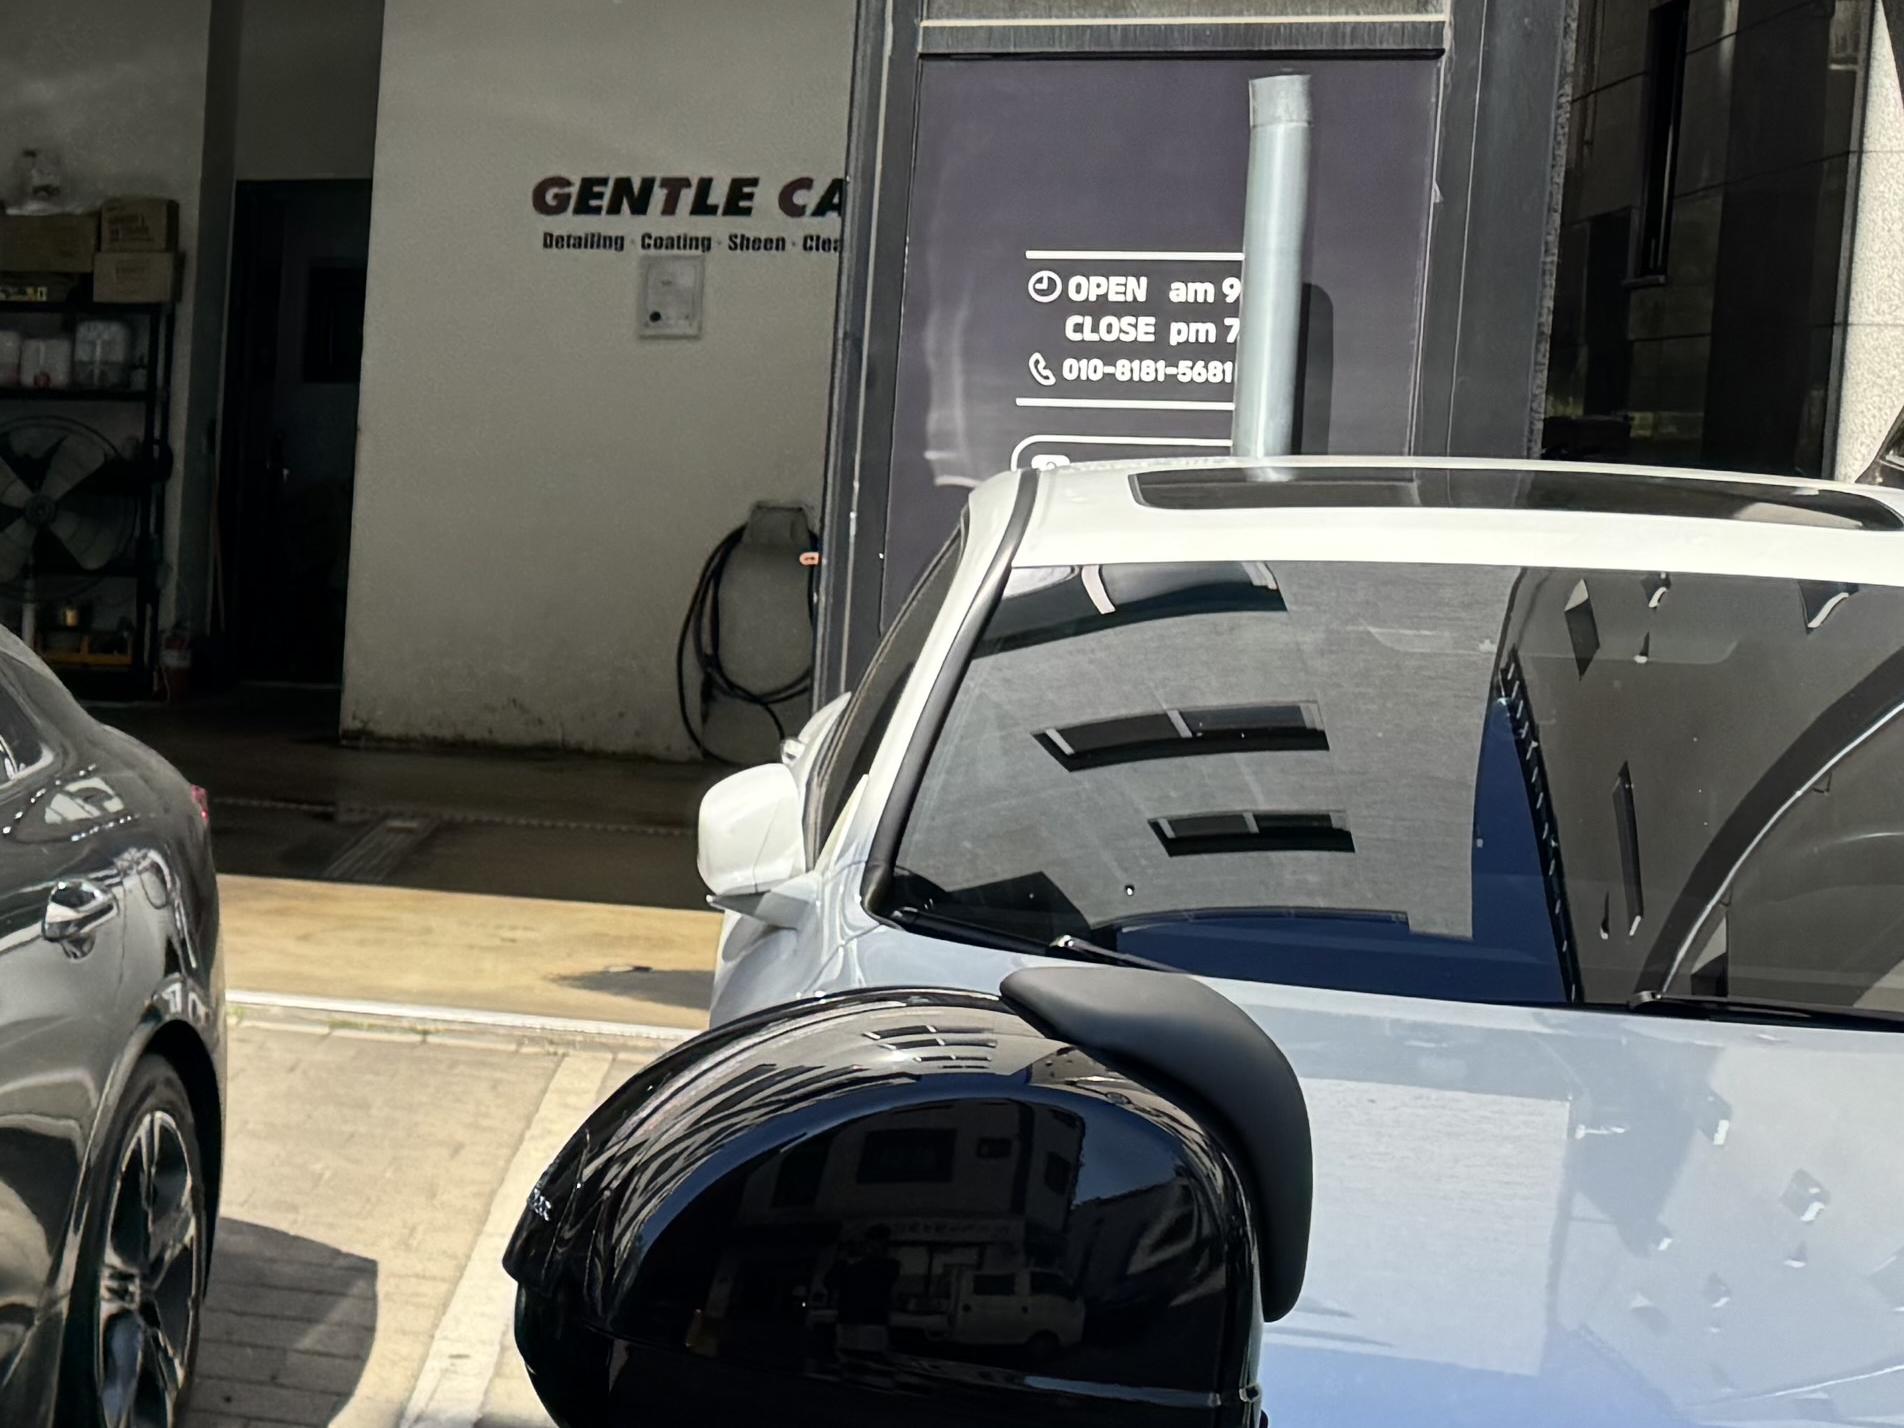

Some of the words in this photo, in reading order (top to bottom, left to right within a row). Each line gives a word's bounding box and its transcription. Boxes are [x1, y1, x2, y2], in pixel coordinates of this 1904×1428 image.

[531, 175, 760, 218] GENTLE
[542, 232, 625, 253] Detailing
[641, 232, 712, 253] Coating
[727, 233, 787, 252] Sheen
[1067, 275, 1147, 303] OPEN
[1169, 280, 1215, 303] am
[1065, 315, 1156, 343] CLOSE
[1169, 320, 1216, 346] pm
[1062, 358, 1234, 384] 010-8181-5681
